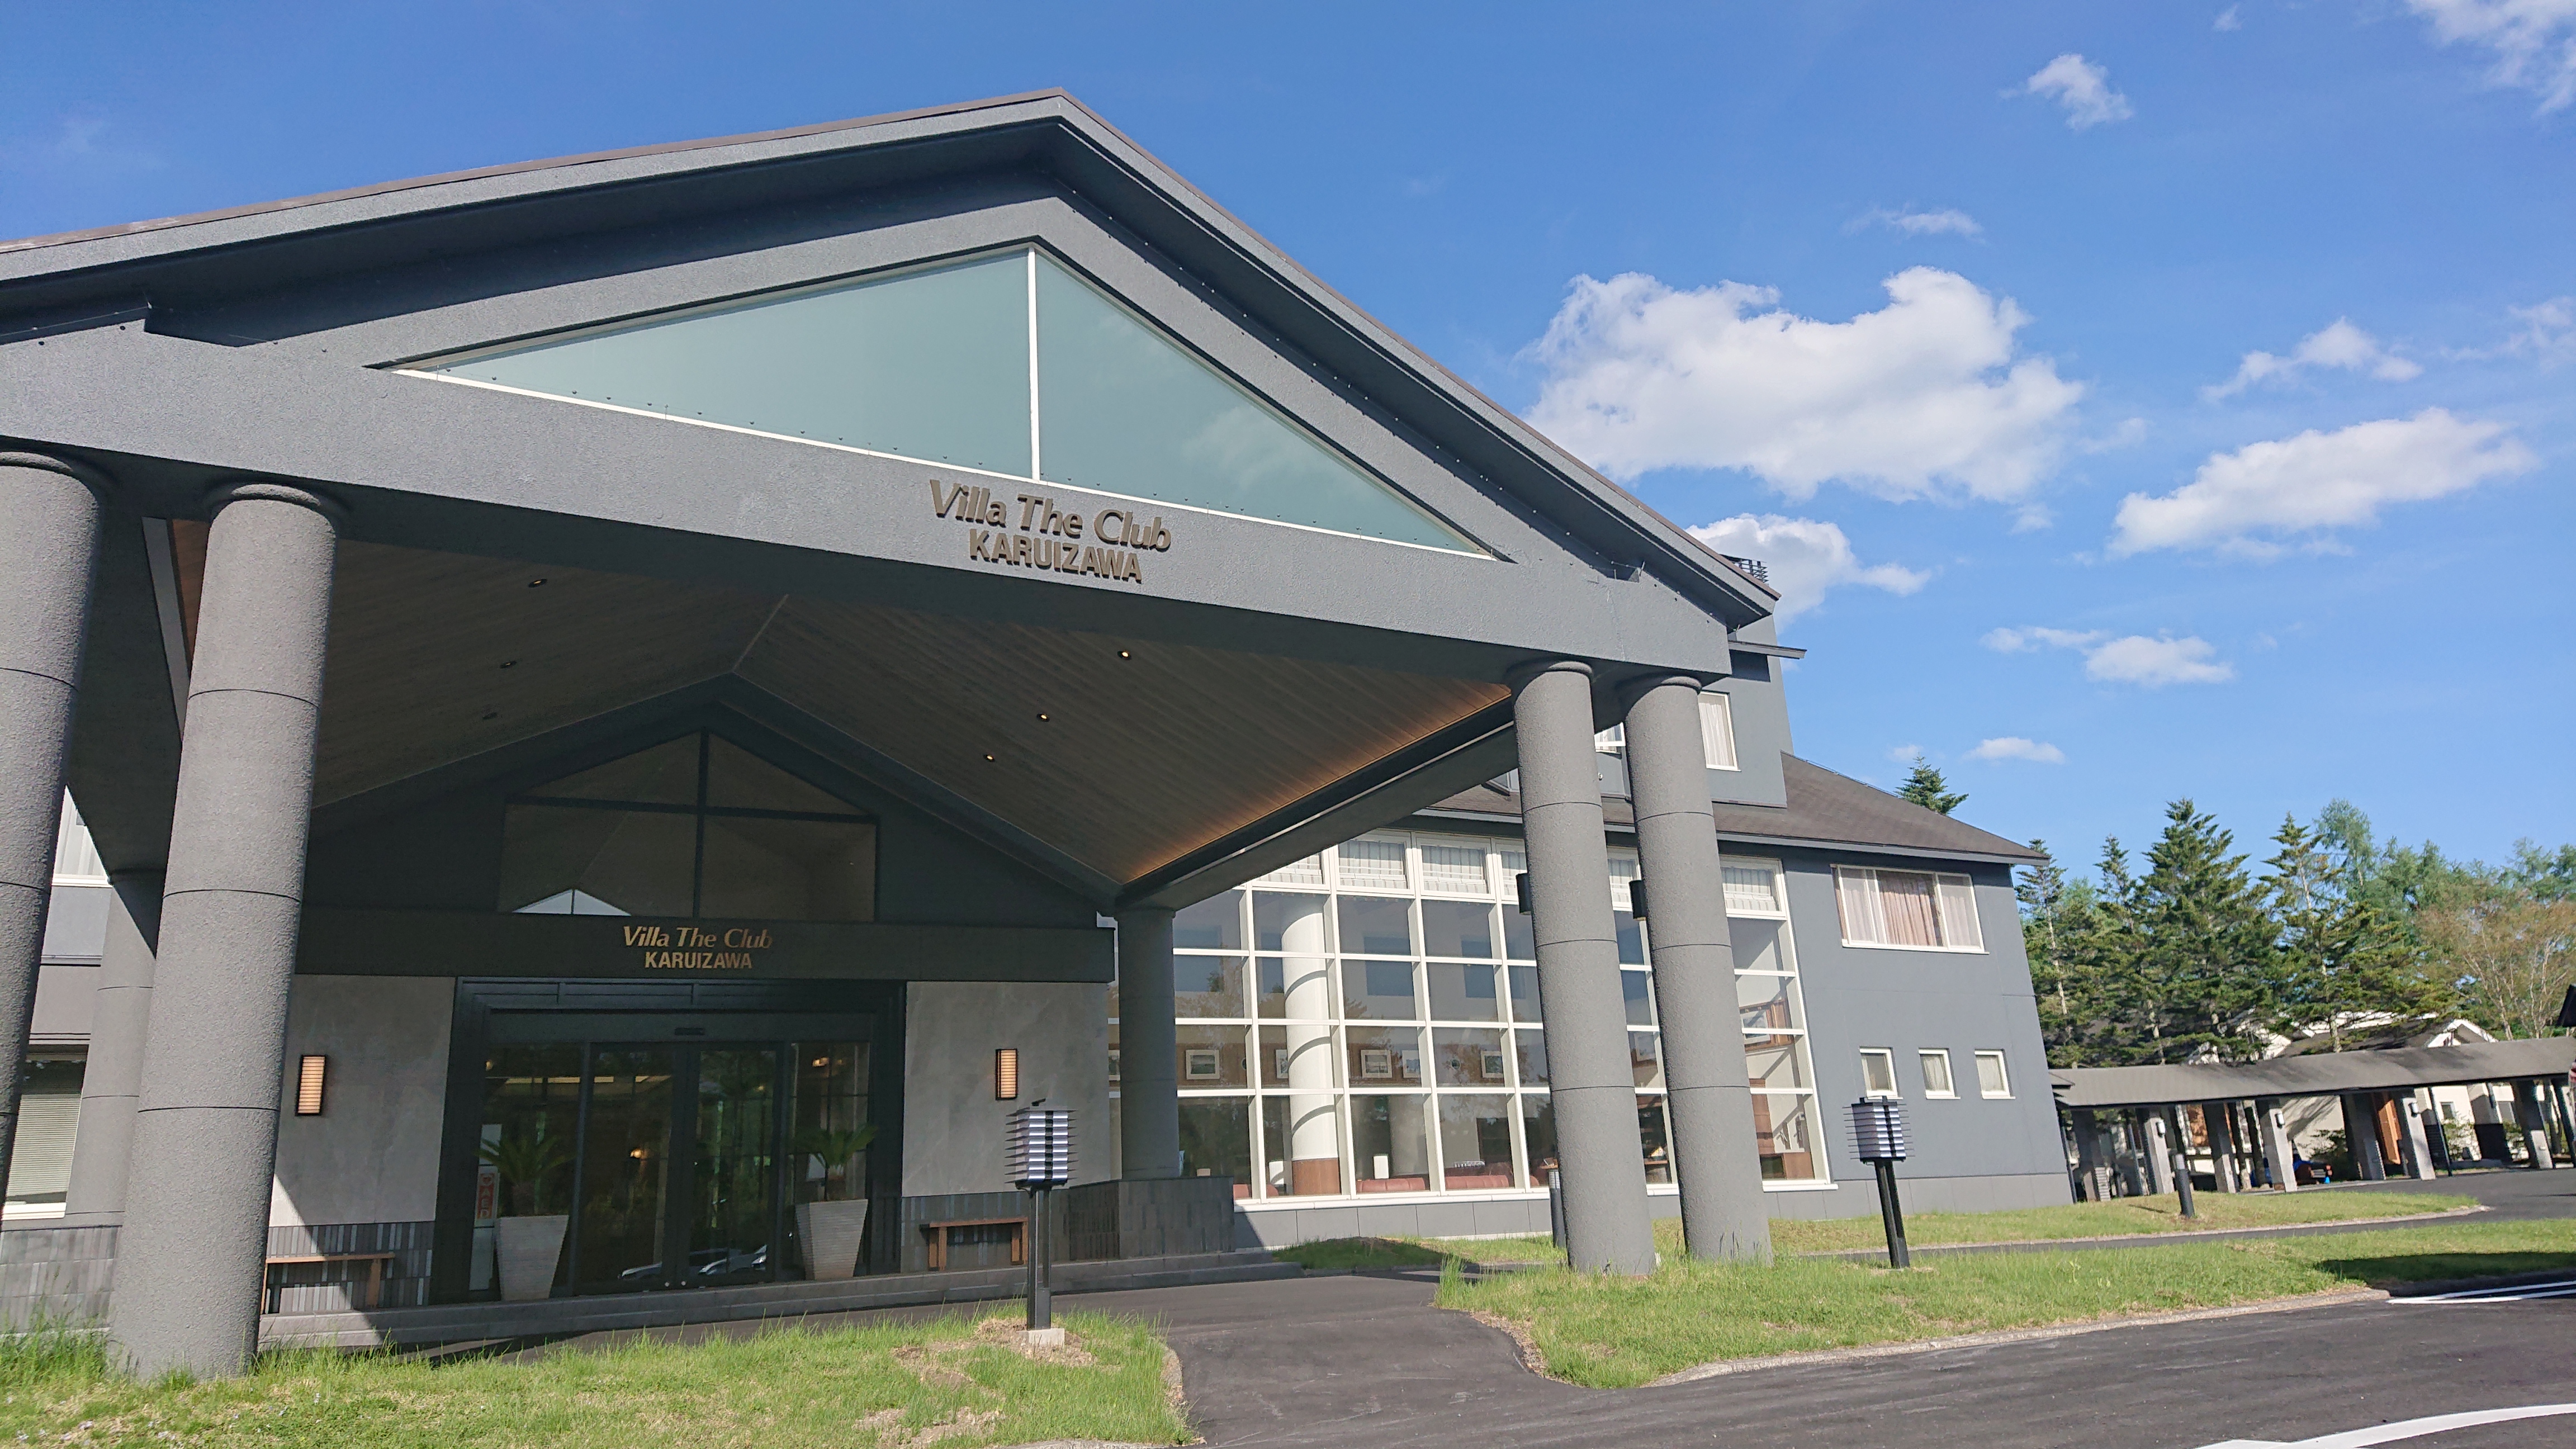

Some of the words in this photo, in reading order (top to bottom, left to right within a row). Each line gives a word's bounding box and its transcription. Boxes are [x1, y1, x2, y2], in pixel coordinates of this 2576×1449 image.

[930, 479, 1006, 528] Villa
[1017, 494, 1083, 538] The
[1094, 509, 1171, 552] Club
[969, 529, 1142, 584] KARUIZAWA
[623, 926, 670, 947] Villa
[676, 927, 717, 948] The
[724, 929, 773, 949] Club
[645, 951, 753, 969] KARUIZAWA
[480, 1188, 491, 1218] AED
